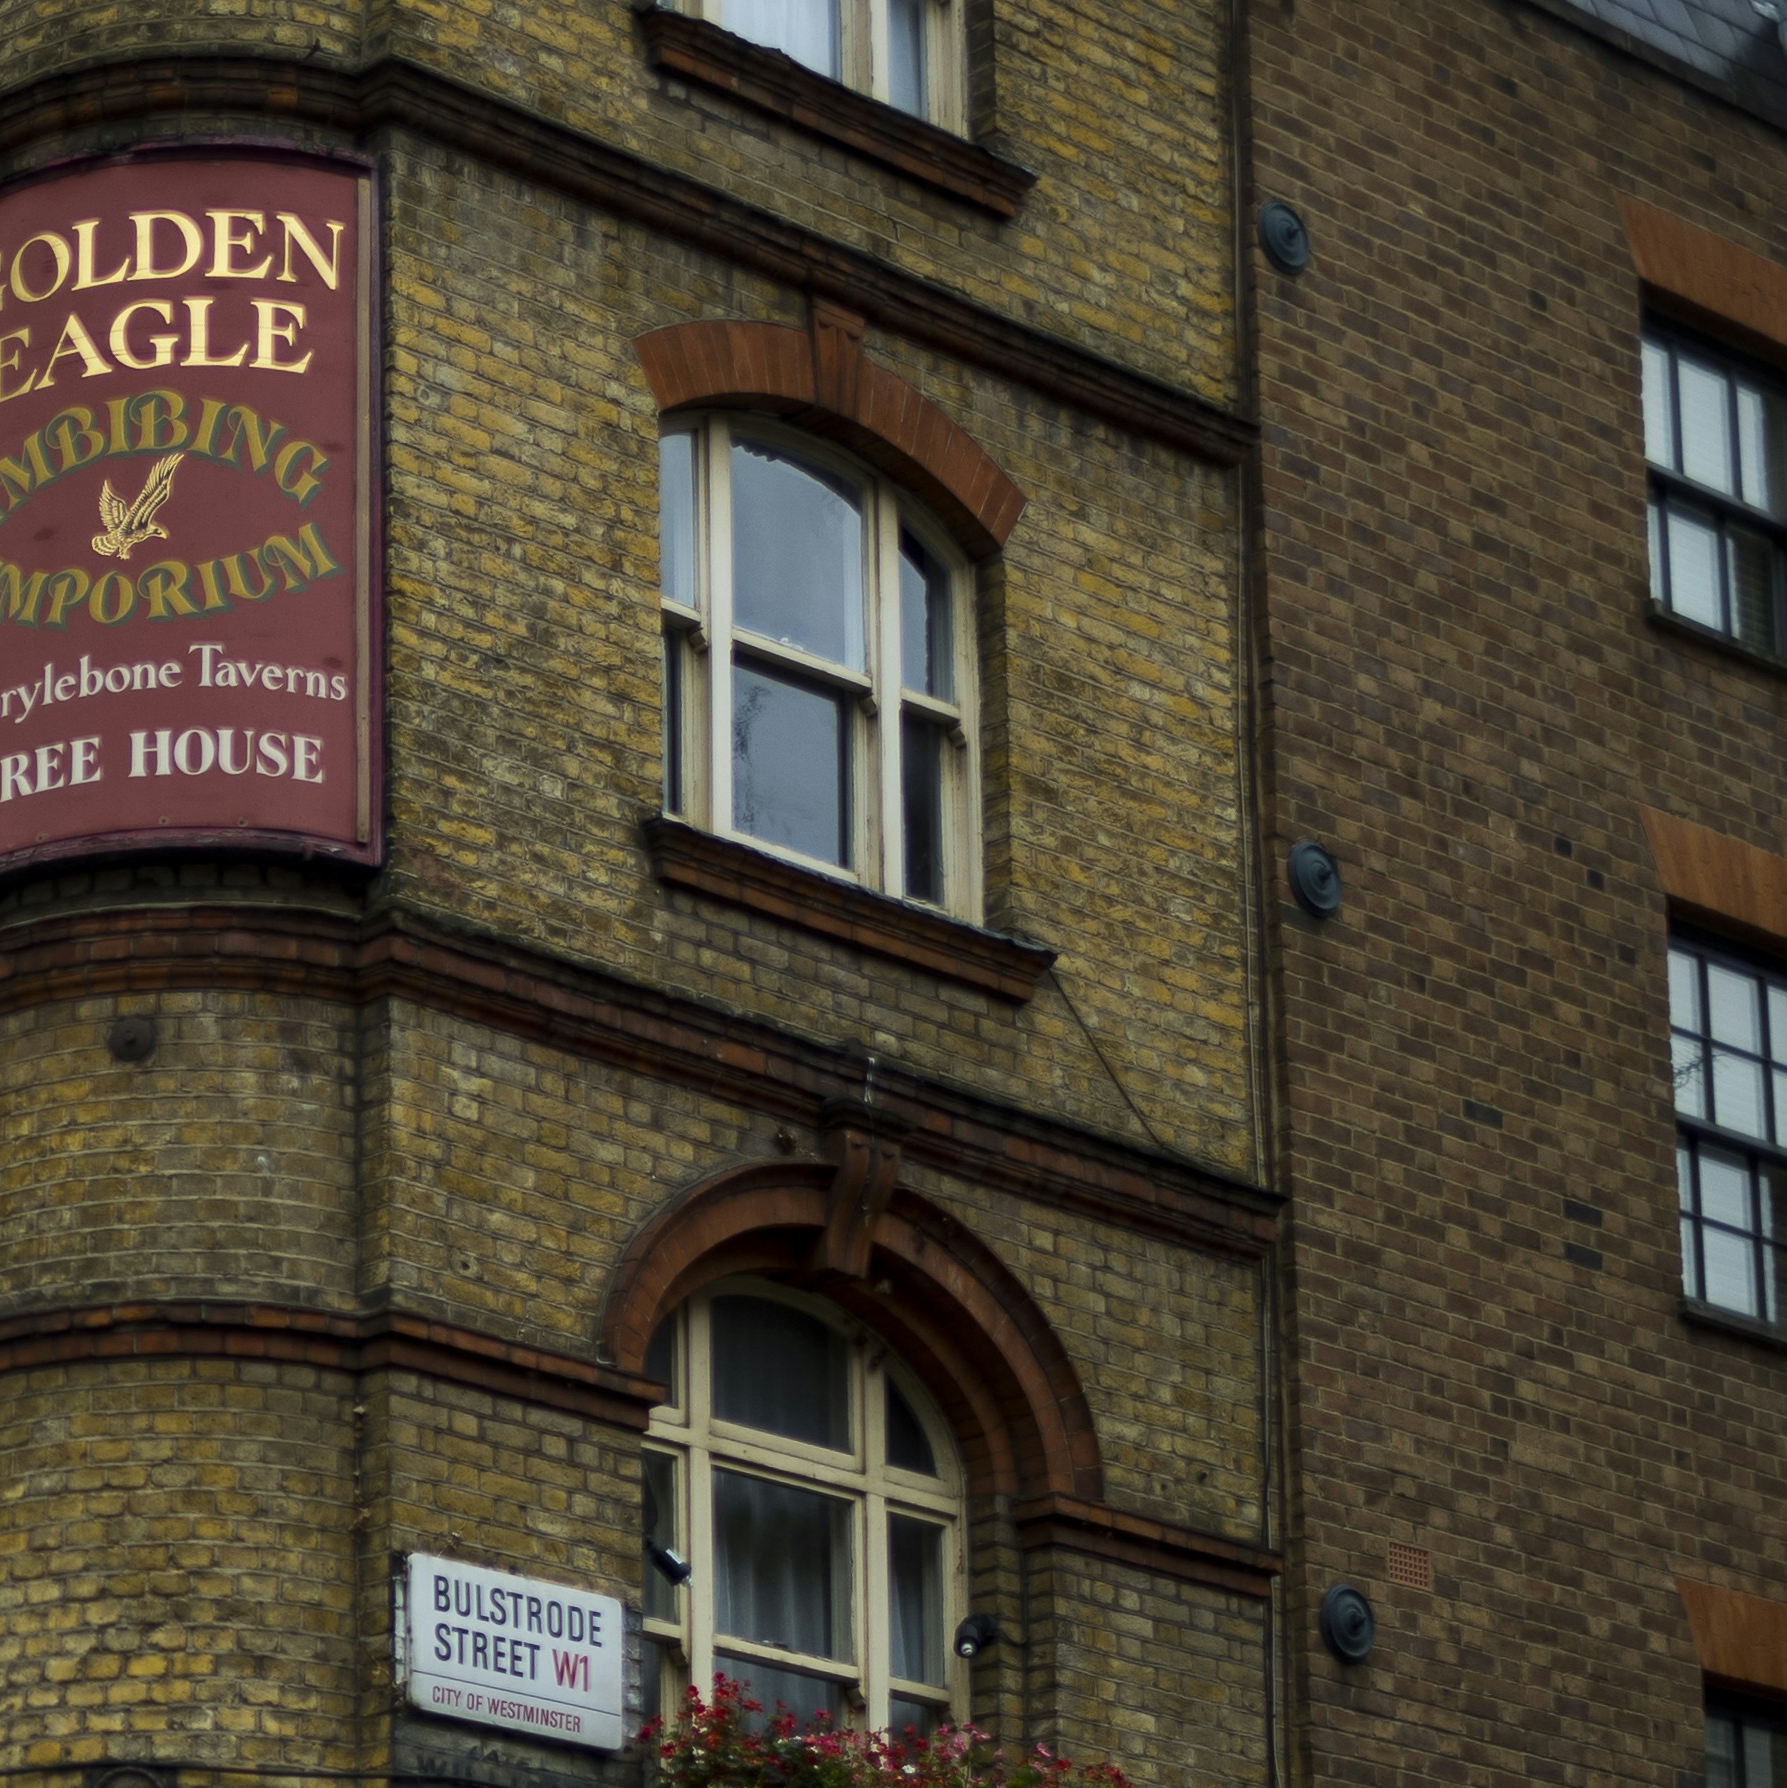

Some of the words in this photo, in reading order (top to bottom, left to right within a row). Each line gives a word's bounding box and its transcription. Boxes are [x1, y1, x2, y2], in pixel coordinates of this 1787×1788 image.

[189, 643, 346, 702] Taverns
[128, 728, 324, 784] HOUSE
[433, 1574, 602, 1648] BULSTRODE
[433, 1622, 540, 1680] STREET
[552, 1648, 590, 1692] W1
[432, 1685, 462, 1707] CITY
[467, 1693, 483, 1711] OF
[487, 1697, 580, 1733] WESTMINSTER
